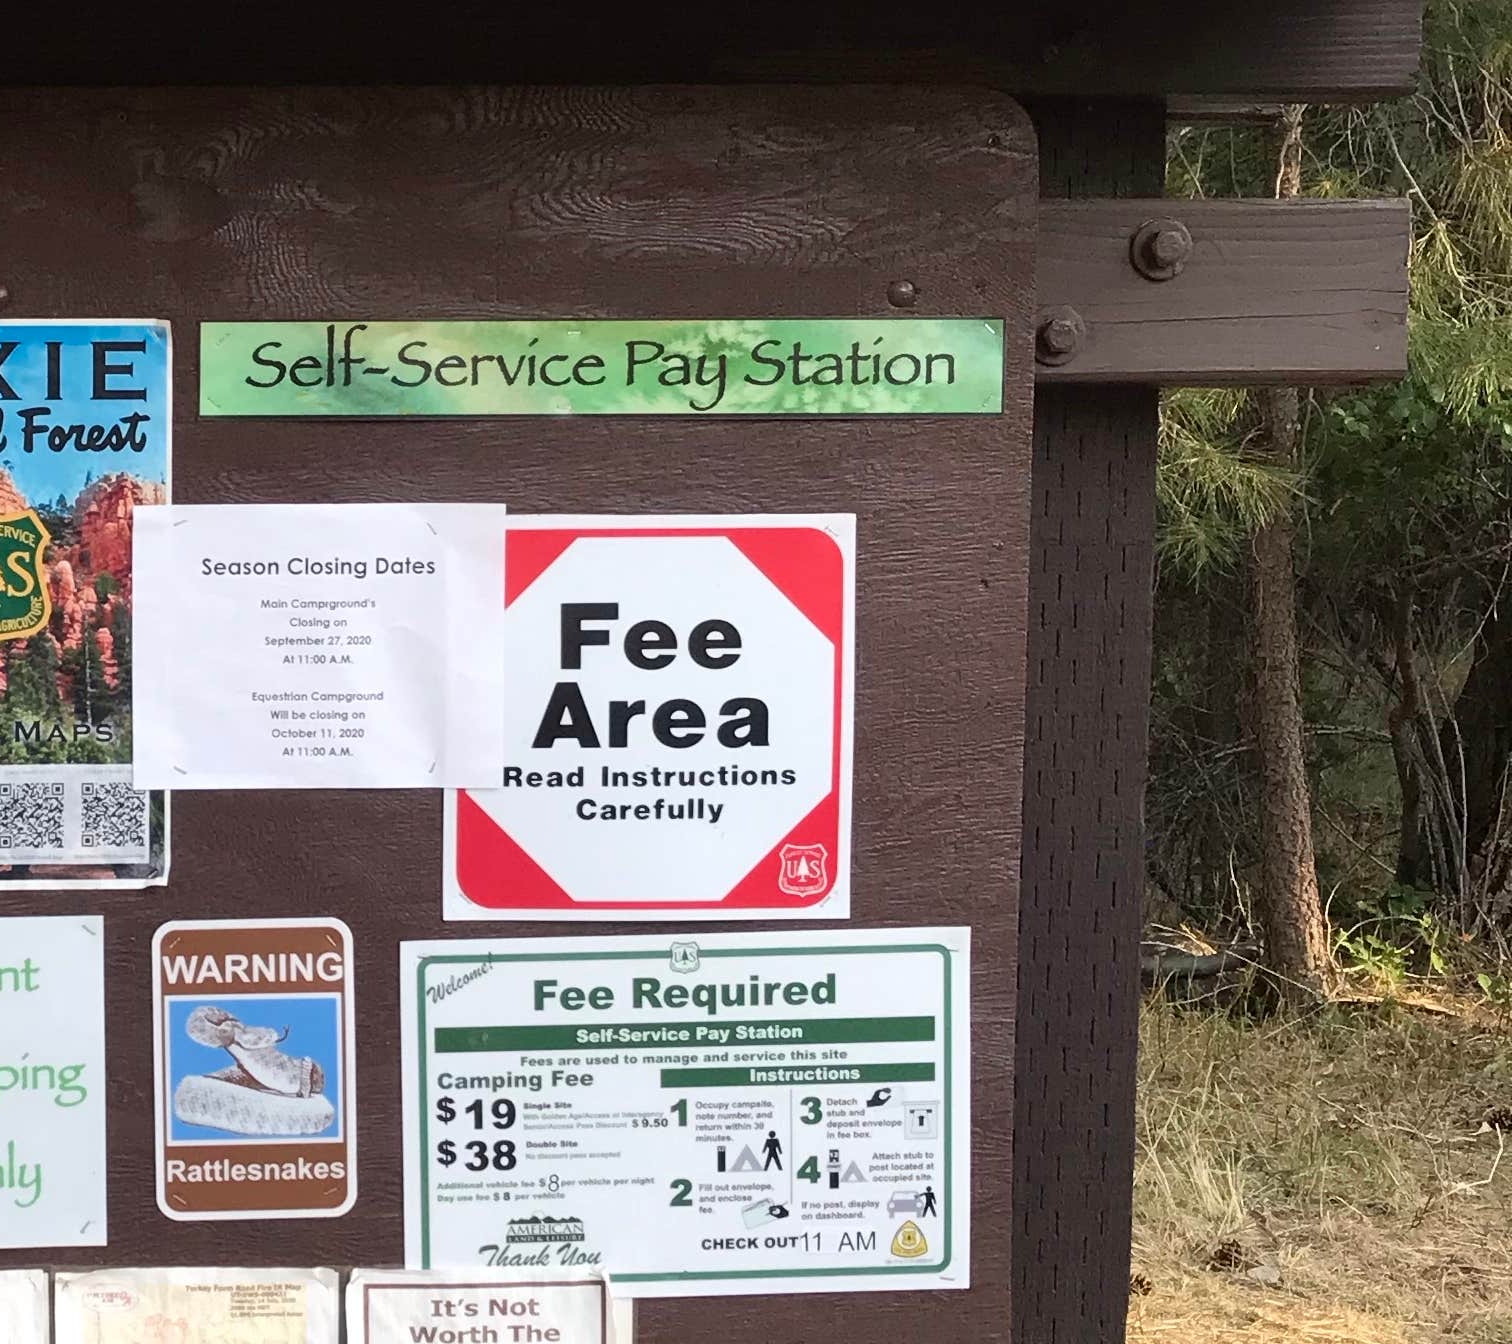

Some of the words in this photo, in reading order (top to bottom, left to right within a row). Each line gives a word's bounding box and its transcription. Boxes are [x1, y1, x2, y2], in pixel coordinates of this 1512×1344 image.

[245, 325, 606, 388] Self-Service
[625, 341, 728, 411] Pay
[744, 336, 956, 386] Station
[17, 408, 150, 453] Forest
[202, 558, 279, 576] Season
[288, 557, 367, 578] Closing
[375, 557, 436, 575] Dates
[261, 599, 288, 608] Main
[289, 617, 330, 628] Closing
[265, 636, 324, 648] September
[328, 636, 343, 647] 27,
[347, 636, 371, 645] 2020
[560, 603, 742, 670] Fee
[283, 655, 295, 664] At
[298, 655, 326, 664] 11:00
[330, 655, 353, 664] A.M.
[252, 692, 307, 704] Equestrian
[311, 691, 384, 703] Campground
[270, 711, 289, 719] Will
[292, 711, 306, 719] be
[310, 710, 348, 722] closing
[532, 682, 769, 749] Area
[14, 720, 114, 744] MAPS
[271, 729, 316, 738] October
[320, 729, 335, 739] 11,
[339, 728, 365, 738] 2020
[283, 747, 295, 756] At
[298, 747, 326, 756] 11:00
[330, 747, 353, 756] A.M.
[504, 767, 584, 787] Read
[601, 765, 797, 787] Instructions
[576, 799, 724, 823] Carefully
[163, 952, 343, 984] WARNING
[427, 952, 493, 1004] Welcome!
[534, 980, 614, 1010] Fee
[632, 973, 836, 1015] Required
[576, 1026, 689, 1044] Self-Service
[696, 1027, 731, 1042] Pay
[736, 1025, 803, 1040] Station
[520, 1057, 553, 1066] Fees
[558, 1057, 581, 1066] are
[586, 1056, 619, 1065] used
[623, 1056, 638, 1064] to
[642, 1054, 699, 1065] manage
[703, 1052, 729, 1061] and
[734, 1052, 785, 1061] service
[790, 1050, 817, 1060] this
[822, 1049, 848, 1059] site
[437, 1073, 542, 1092] Camping
[552, 1070, 594, 1086] Fee
[750, 1068, 860, 1082] Instructions
[670, 1098, 687, 1126] 1
[800, 1097, 822, 1125] 3
[167, 1157, 345, 1183] Rattlesnakes
[797, 1156, 821, 1183] 4
[670, 1179, 693, 1206] 2
[507, 1225, 584, 1234] AMERICAN
[702, 1238, 758, 1250] CHECK
[764, 1237, 798, 1248] OUT
[800, 1232, 822, 1252] 11
[839, 1231, 876, 1251] AM
[478, 1244, 550, 1267] Thank
[556, 1243, 602, 1265] You
[431, 1299, 479, 1317] It's
[489, 1298, 540, 1316] Not
[409, 1325, 498, 1344] Worth
[508, 1325, 560, 1342] The
